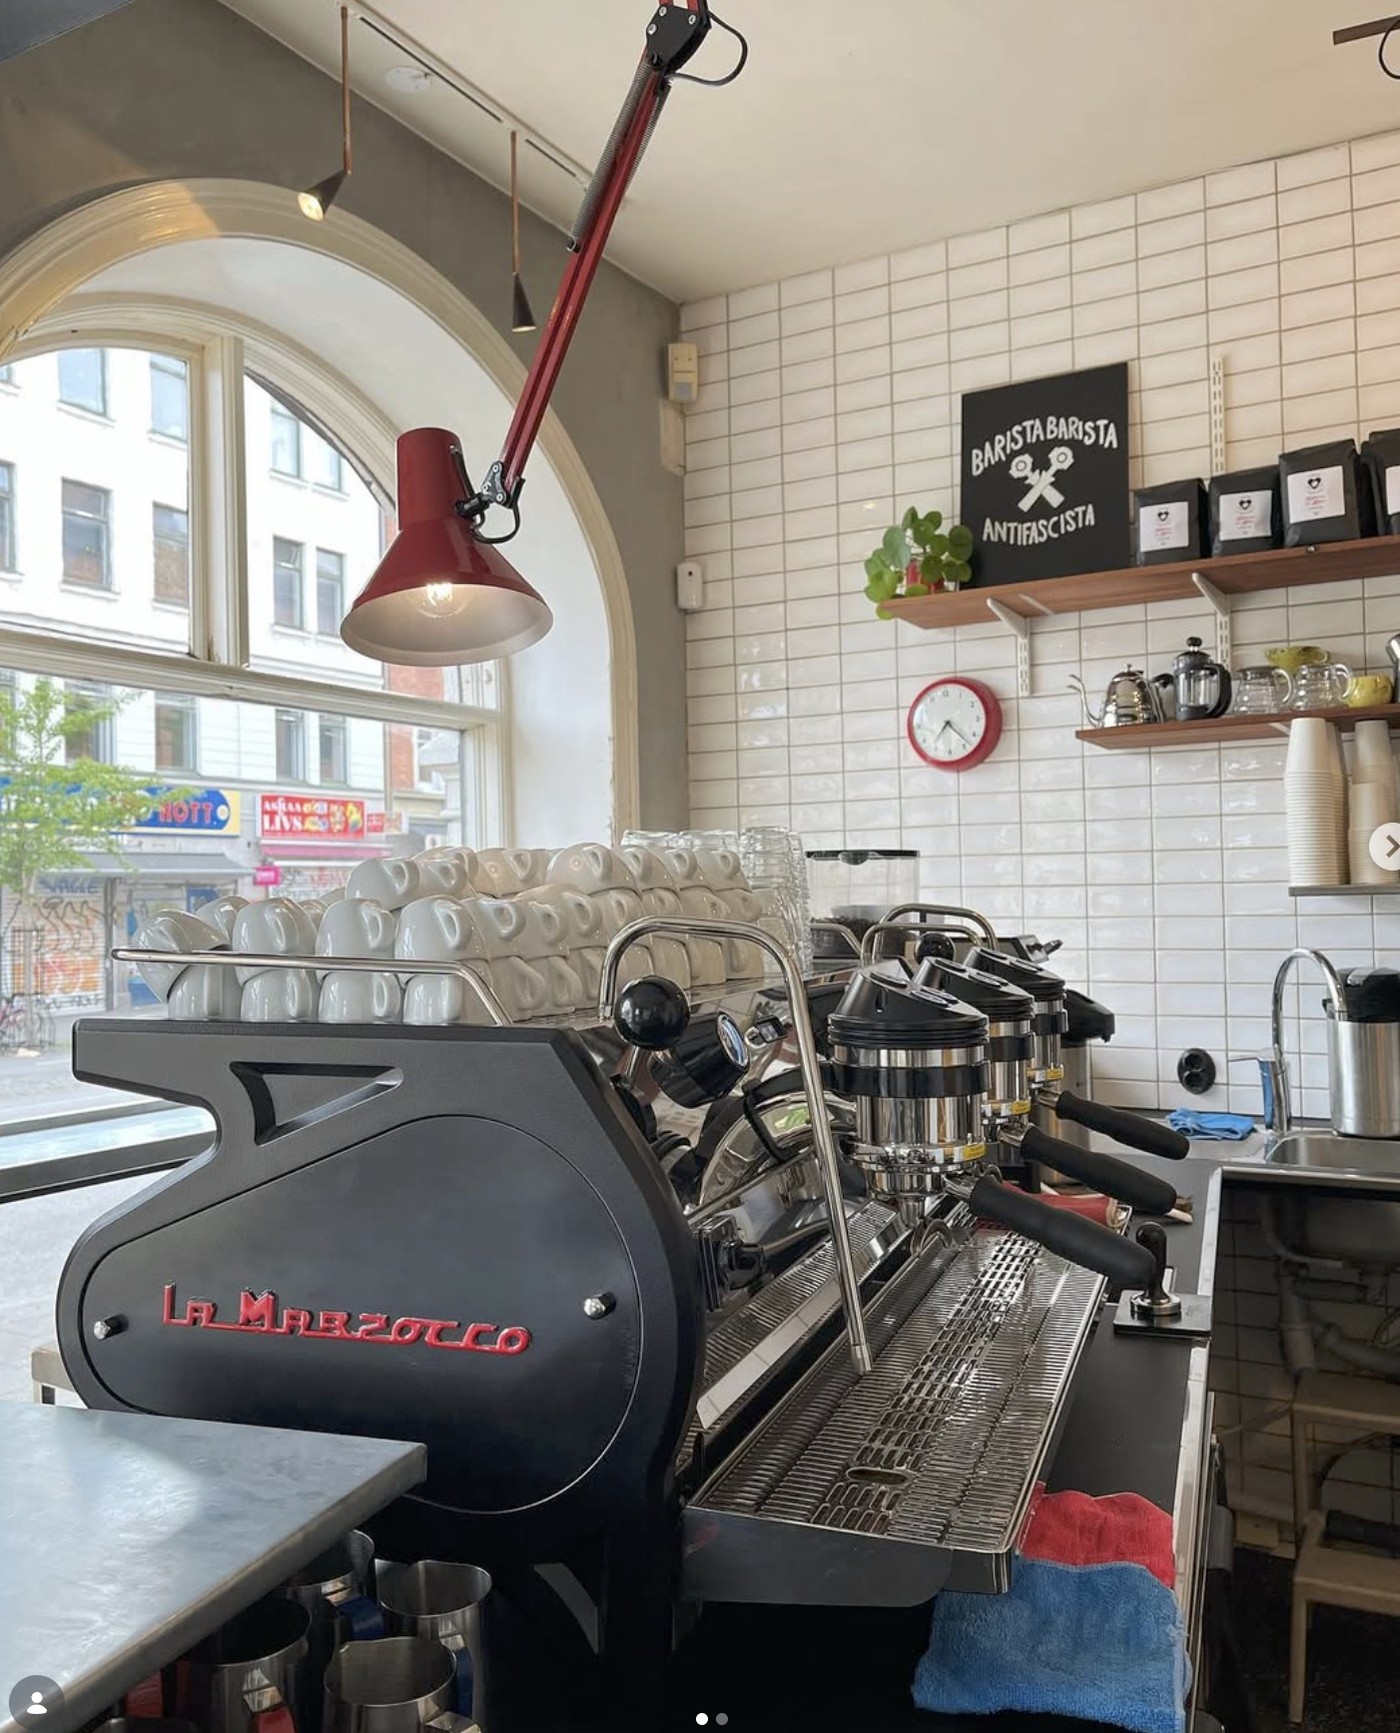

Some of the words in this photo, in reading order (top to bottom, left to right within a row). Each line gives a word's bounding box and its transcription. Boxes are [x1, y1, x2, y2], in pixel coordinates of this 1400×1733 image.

[971, 418, 1044, 476] BARISTA
[1046, 415, 1118, 449] BARISTA
[982, 503, 1095, 546] ANTIFASCISTA
[264, 815, 302, 831] LIVS
